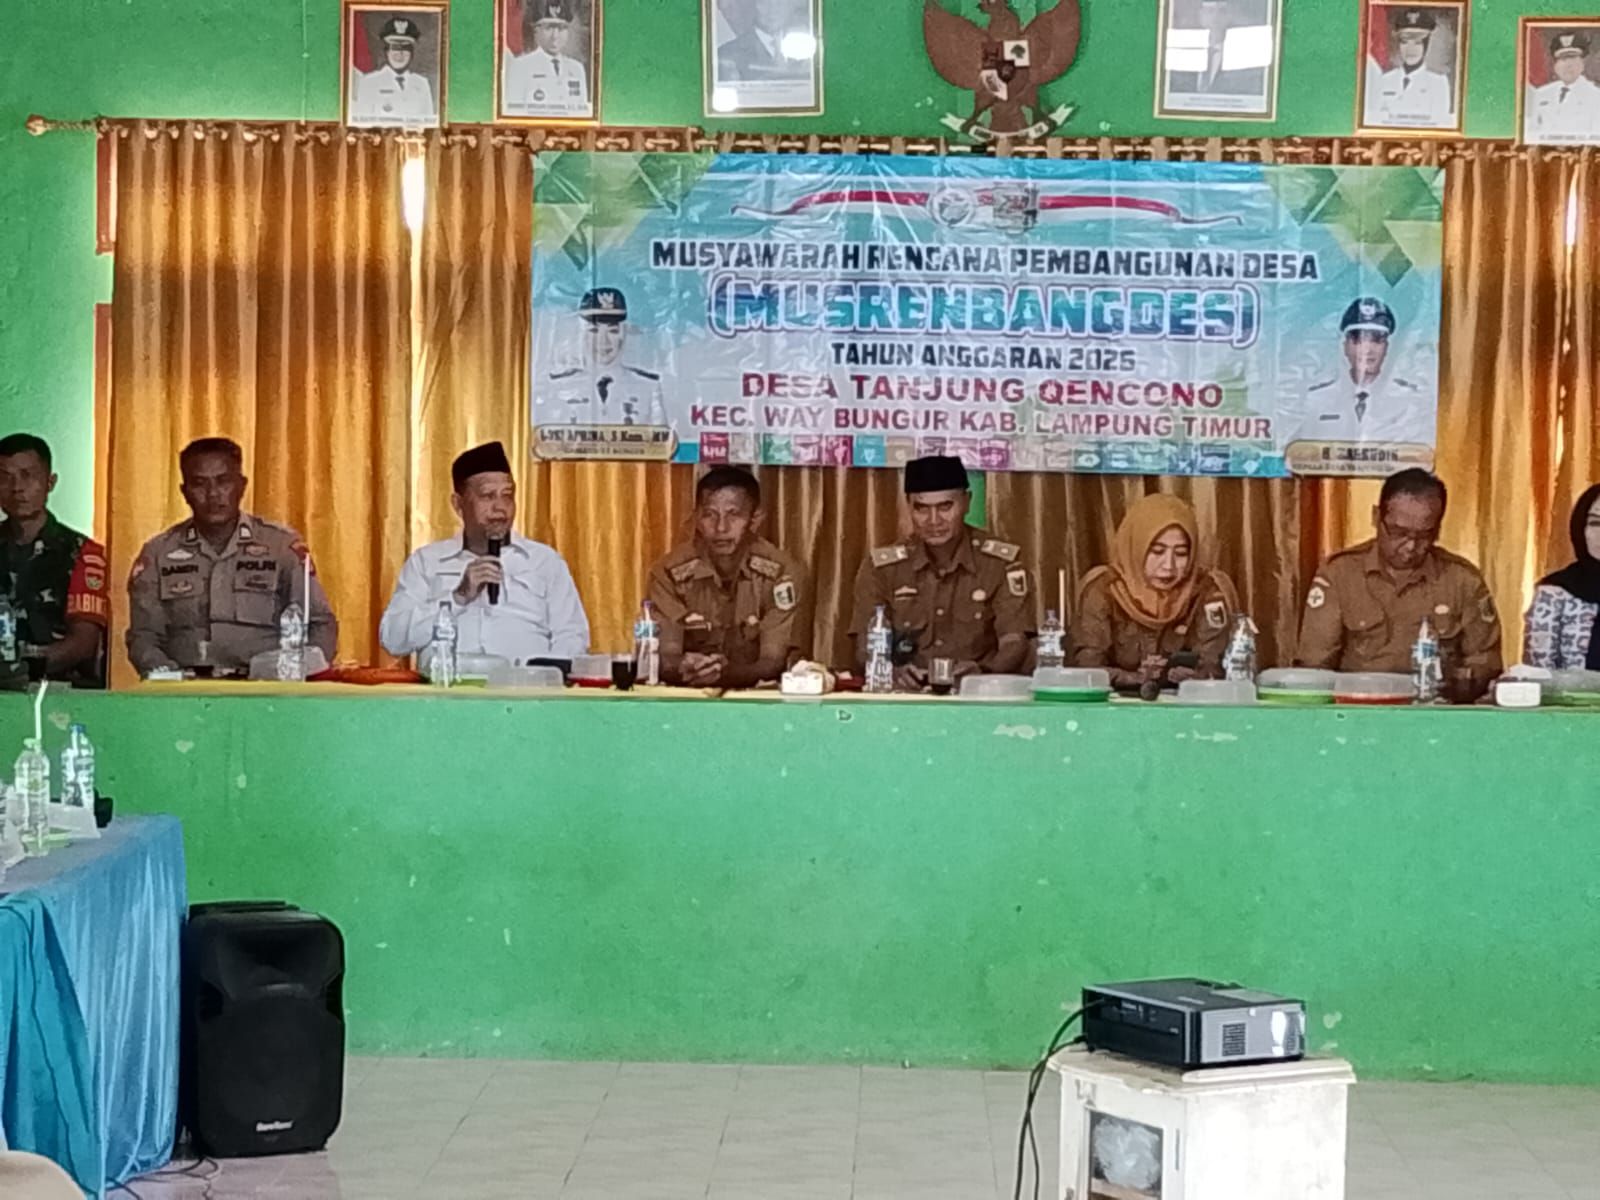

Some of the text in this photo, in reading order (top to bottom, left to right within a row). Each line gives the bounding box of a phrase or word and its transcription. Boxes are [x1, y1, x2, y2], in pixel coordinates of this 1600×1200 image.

[651, 241, 1318, 280] MUSYAWARAH RENCANA PEMBANGUNAN DESA
[831, 342, 1136, 371] TAHUN ANGGARAN 2025
[741, 372, 839, 399] DESA
[849, 374, 1025, 403] TANJUNG
[690, 405, 1272, 439] KEC. WAY BUNGUR KAB. LAMPUNG TIMUR
[236, 560, 277, 572] POLRI
